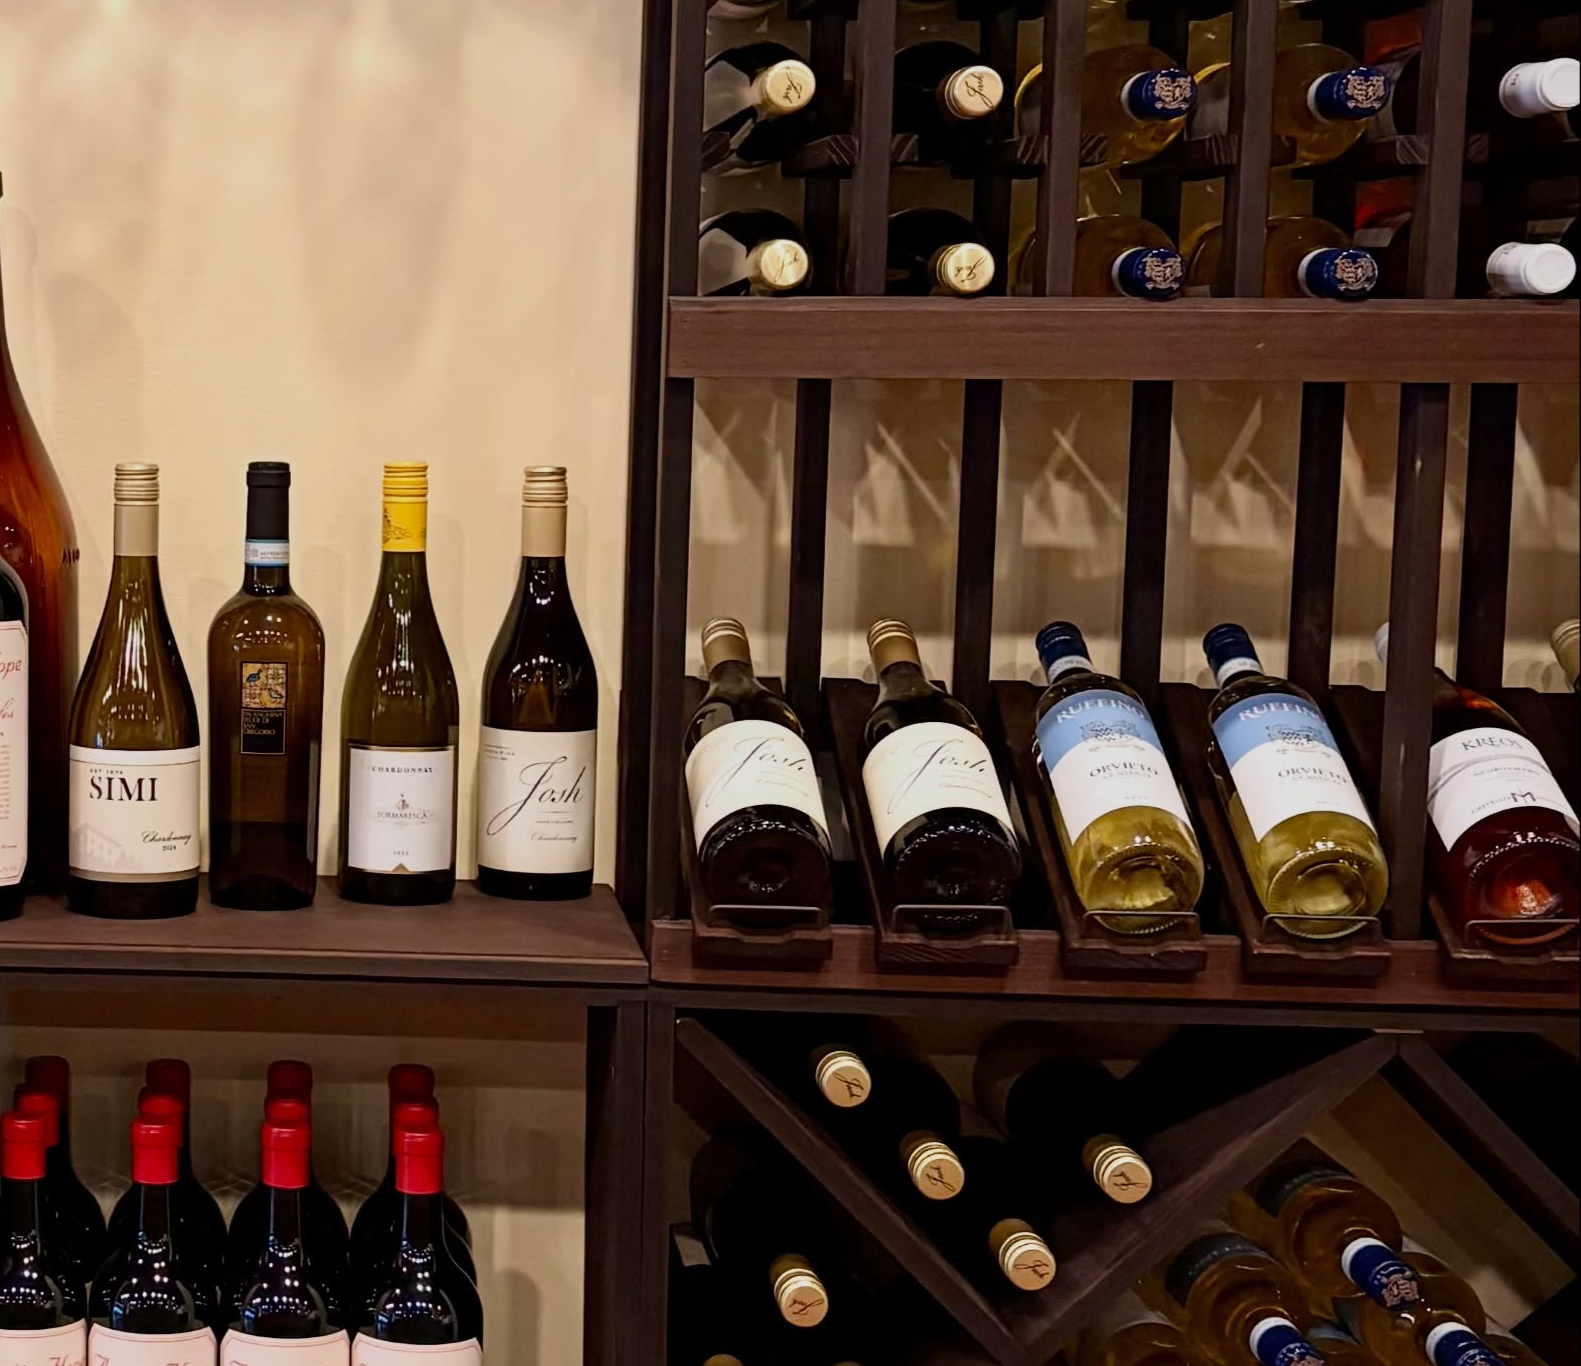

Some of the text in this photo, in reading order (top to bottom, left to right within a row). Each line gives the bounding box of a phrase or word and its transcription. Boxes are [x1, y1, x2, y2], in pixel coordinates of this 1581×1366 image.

[1462, 736, 1524, 751] KREOS
[89, 775, 159, 802] SIMI
[486, 755, 587, 836] Josh
[141, 830, 192, 846] Chardonnay
